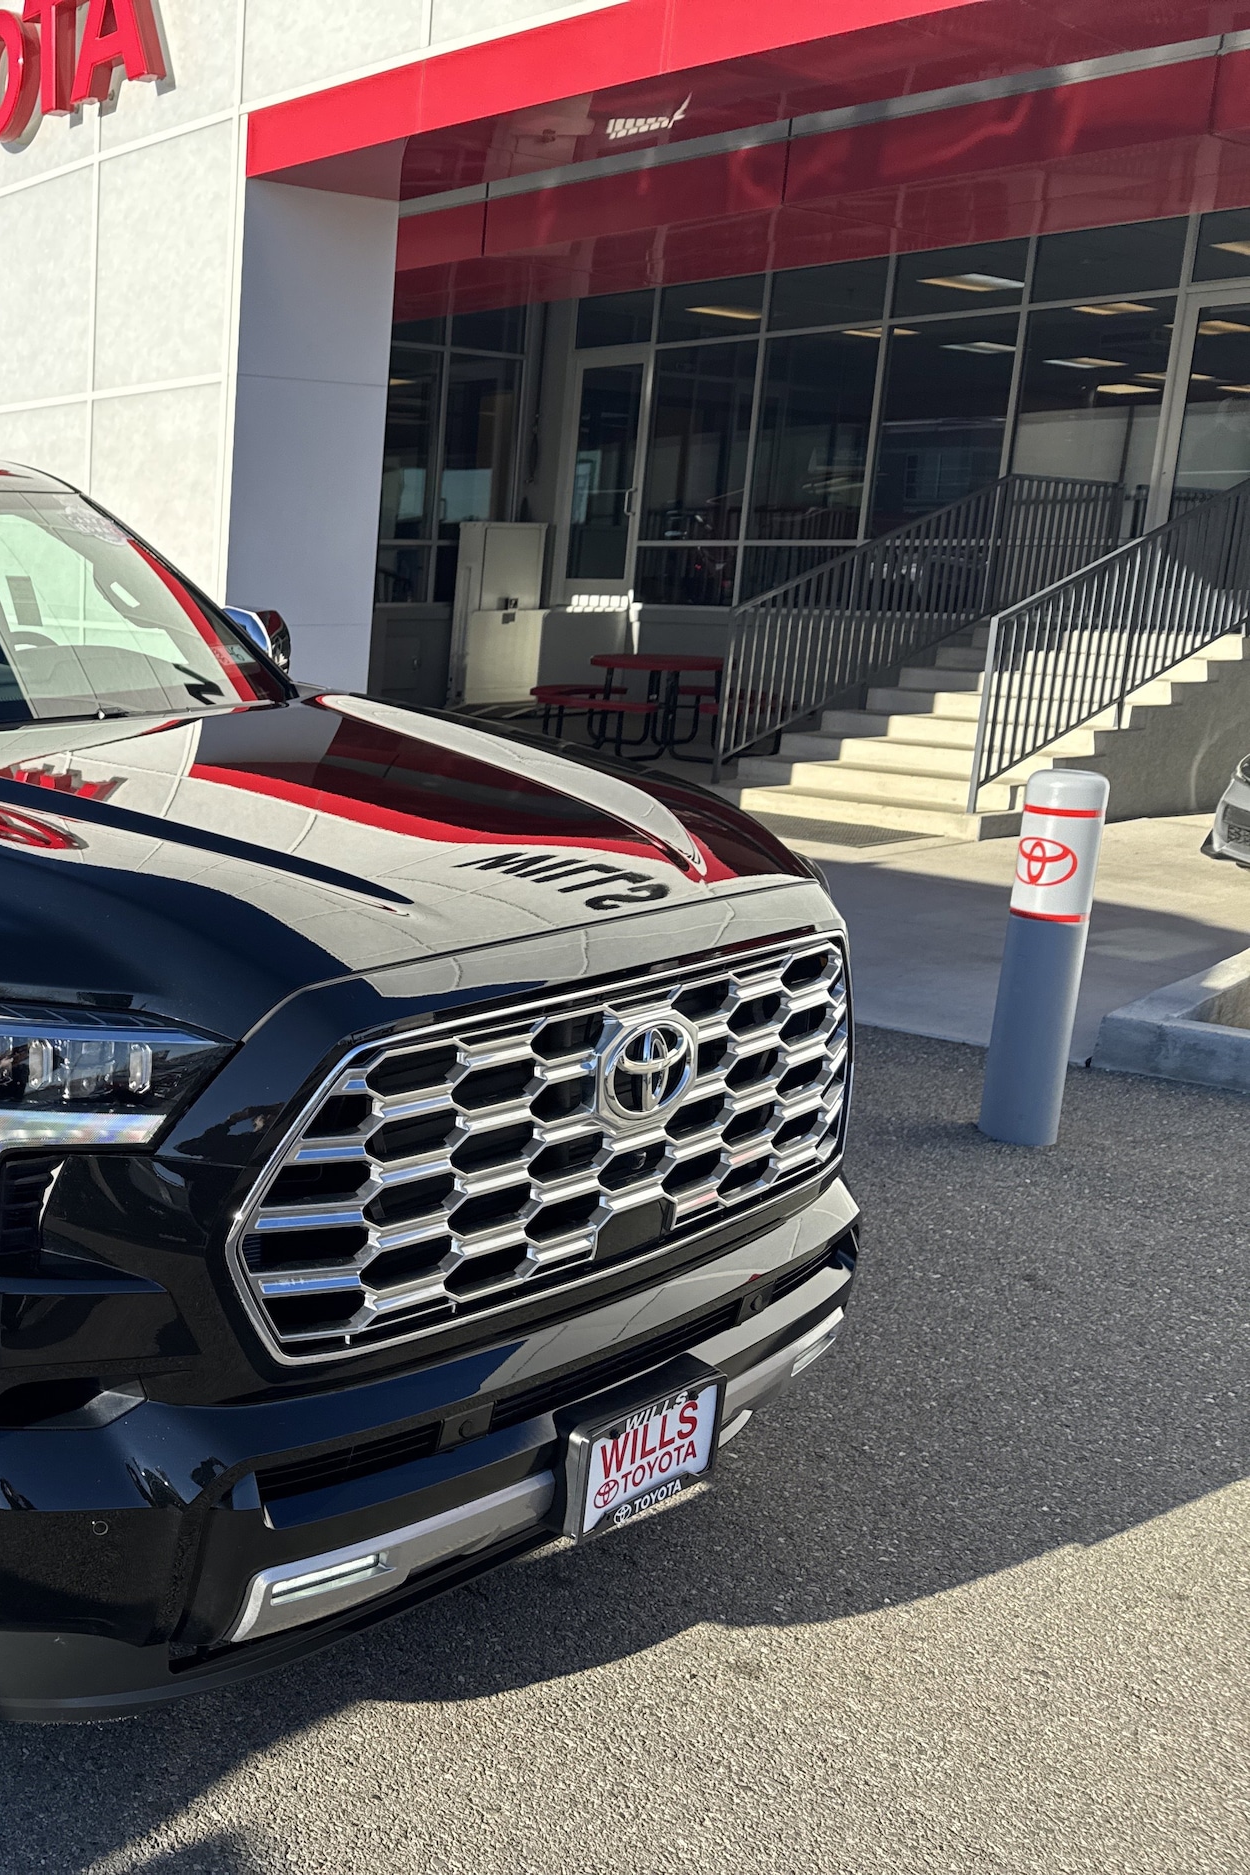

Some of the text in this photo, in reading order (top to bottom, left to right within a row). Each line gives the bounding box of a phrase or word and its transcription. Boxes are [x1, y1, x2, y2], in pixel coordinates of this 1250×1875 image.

[625, 1390, 689, 1432] WILLS
[601, 1400, 698, 1479] WILLS
[621, 1441, 697, 1493] TOYOTA
[634, 1478, 681, 1513] TOYOTA
